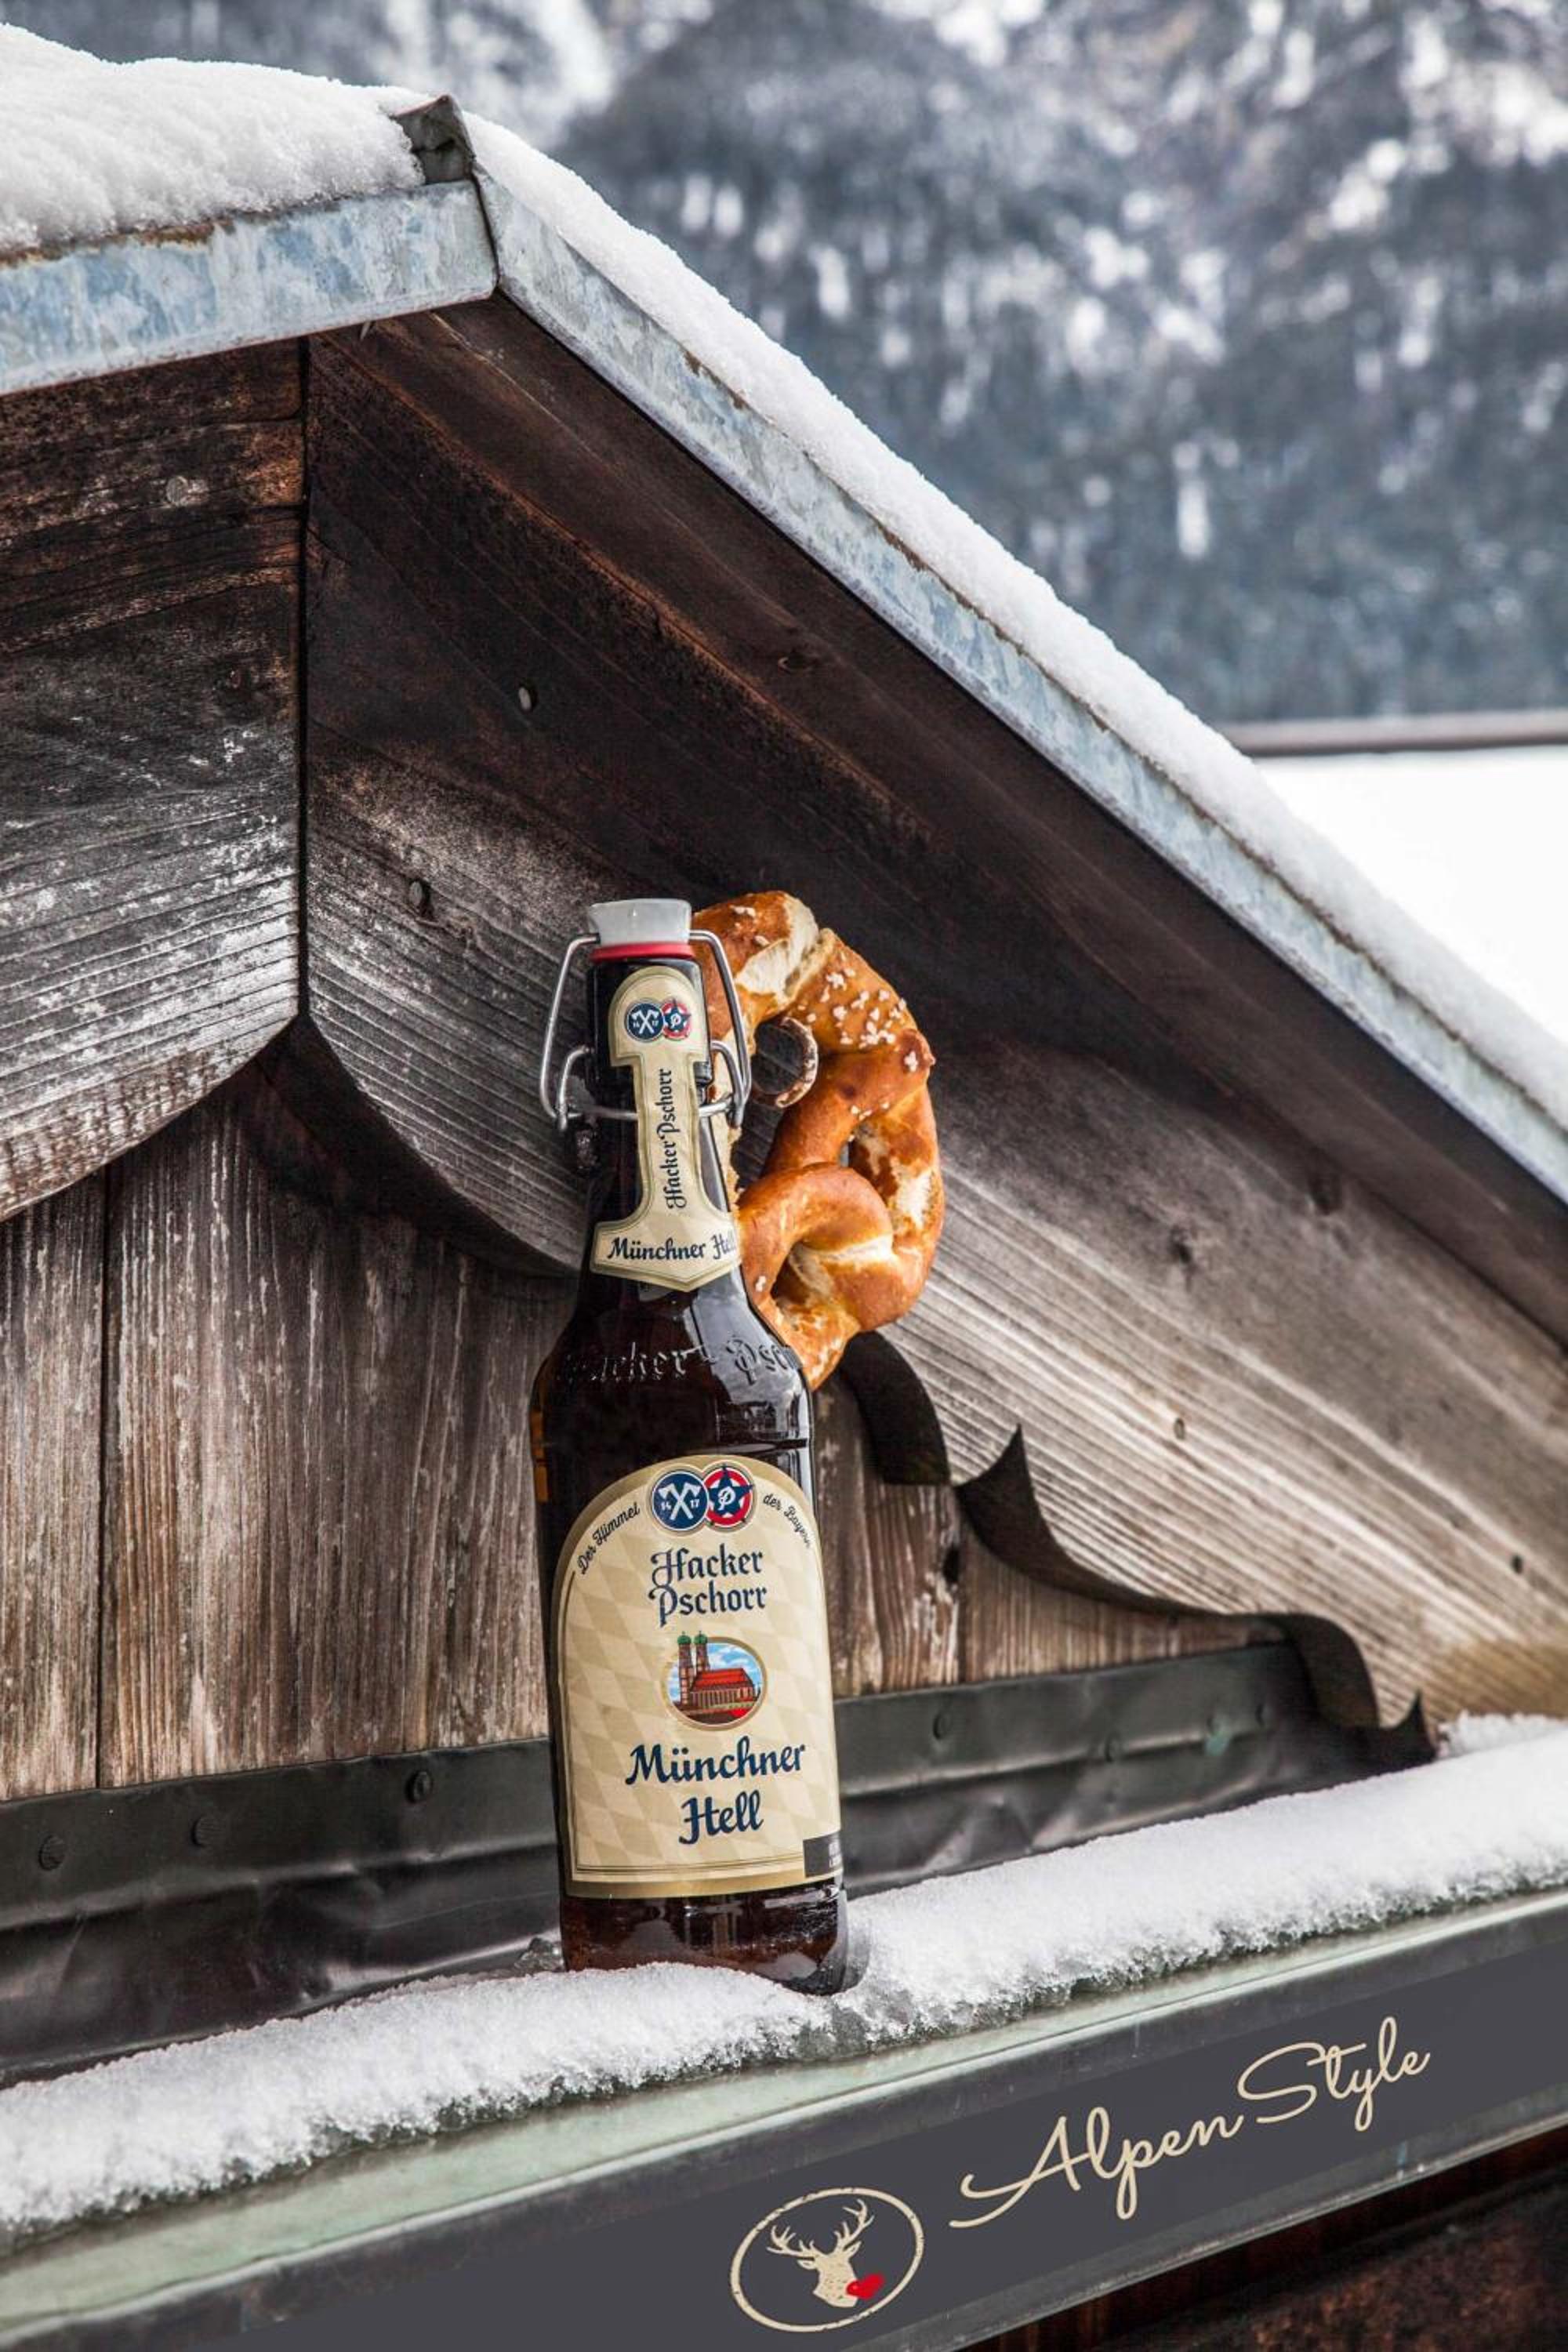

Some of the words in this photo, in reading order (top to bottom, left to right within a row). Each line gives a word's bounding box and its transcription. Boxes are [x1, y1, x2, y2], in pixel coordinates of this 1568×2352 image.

[654, 1069, 681, 1141] Pschorr
[659, 1141, 687, 1209] Hacker
[607, 1236, 706, 1260] Münchner
[577, 1545, 596, 1575] Der
[592, 1501, 641, 1546] Himmel
[762, 1493, 781, 1512] der
[651, 1543, 764, 1587] Hacker
[648, 1580, 768, 1628] Pschorr
[625, 1735, 806, 1785] Münchner
[678, 1789, 764, 1845] Hell
